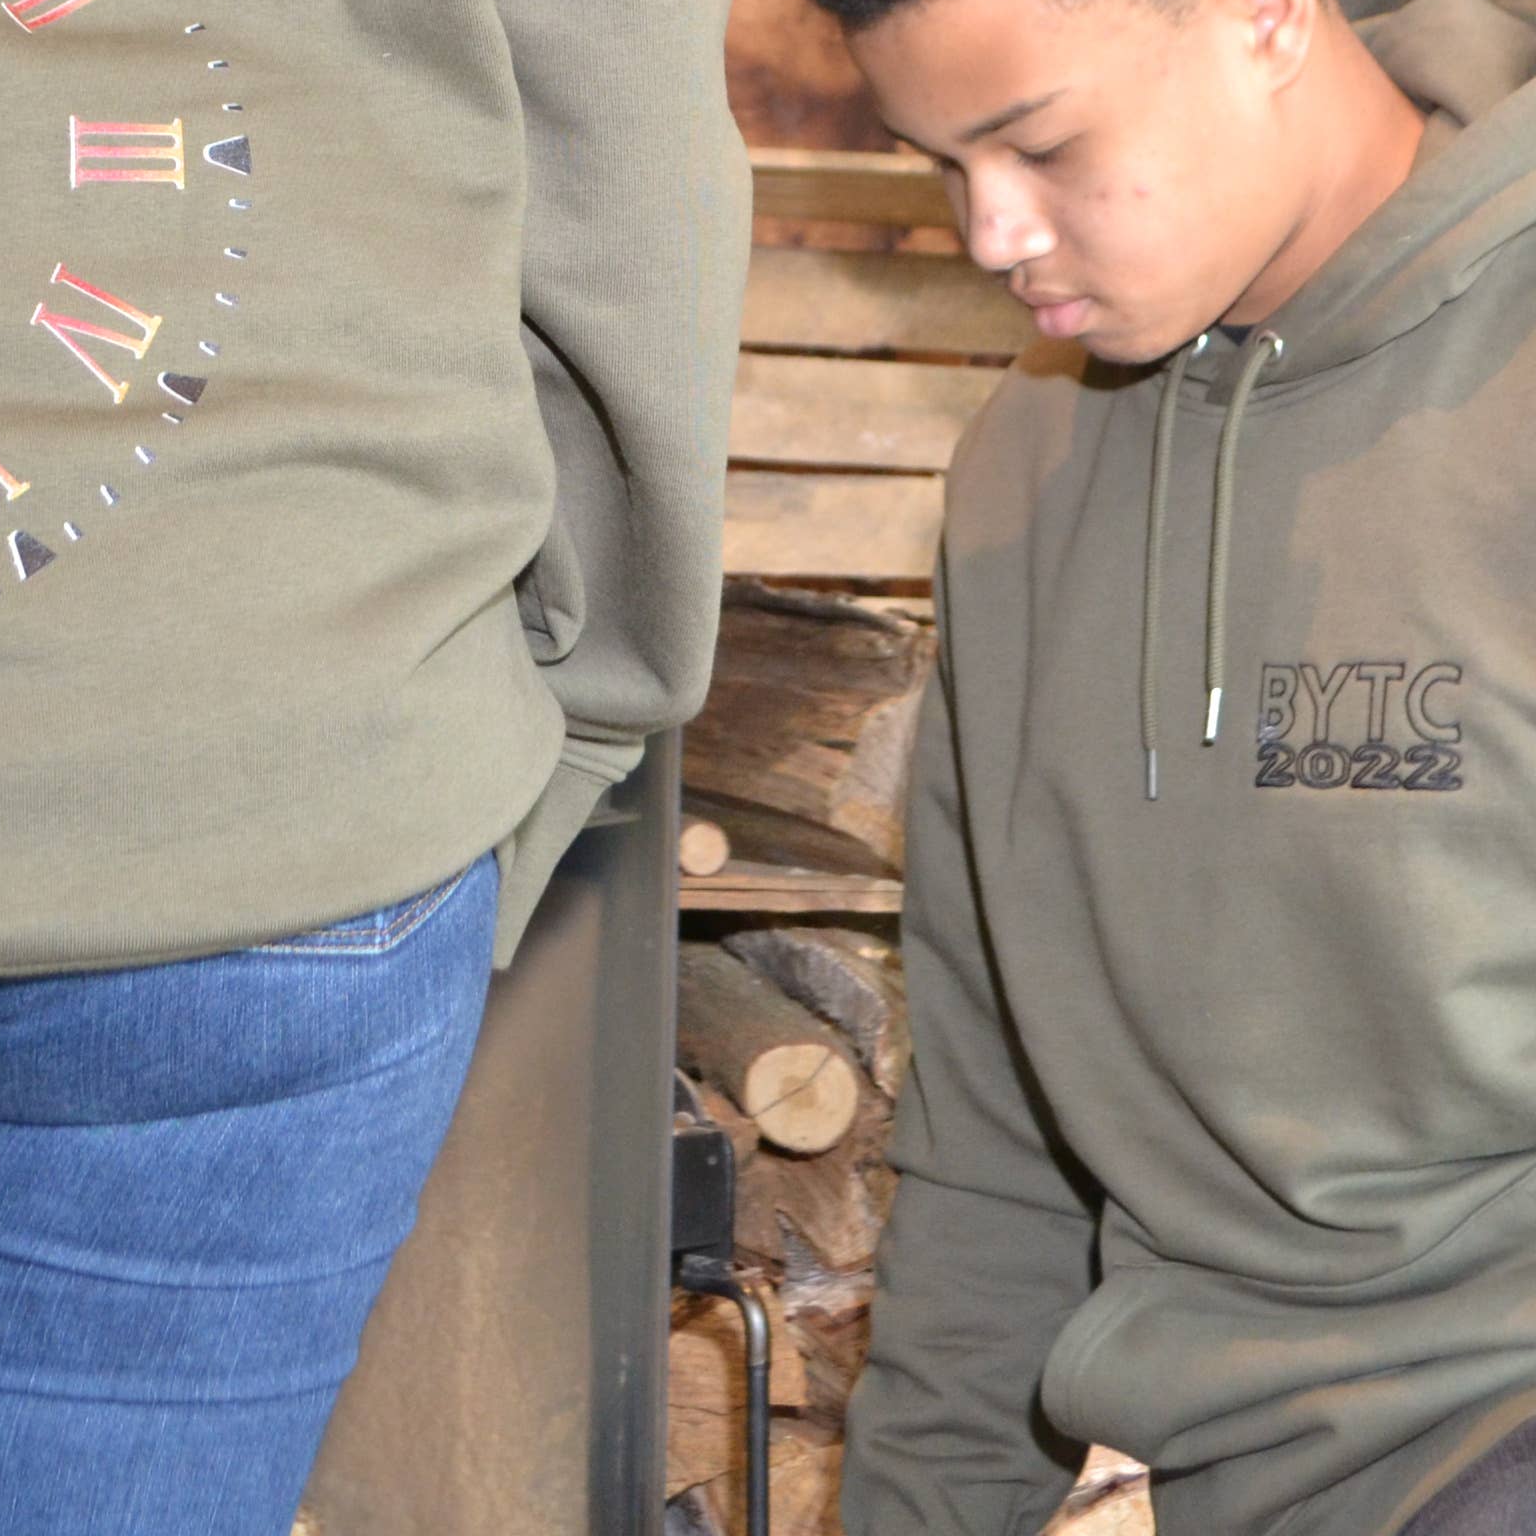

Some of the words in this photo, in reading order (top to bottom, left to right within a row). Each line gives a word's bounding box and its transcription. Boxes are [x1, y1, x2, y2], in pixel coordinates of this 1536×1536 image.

[69, 114, 186, 191] III
[29, 261, 163, 405] IV
[1256, 661, 1463, 745] BYTC
[1253, 740, 1464, 792] 2022
